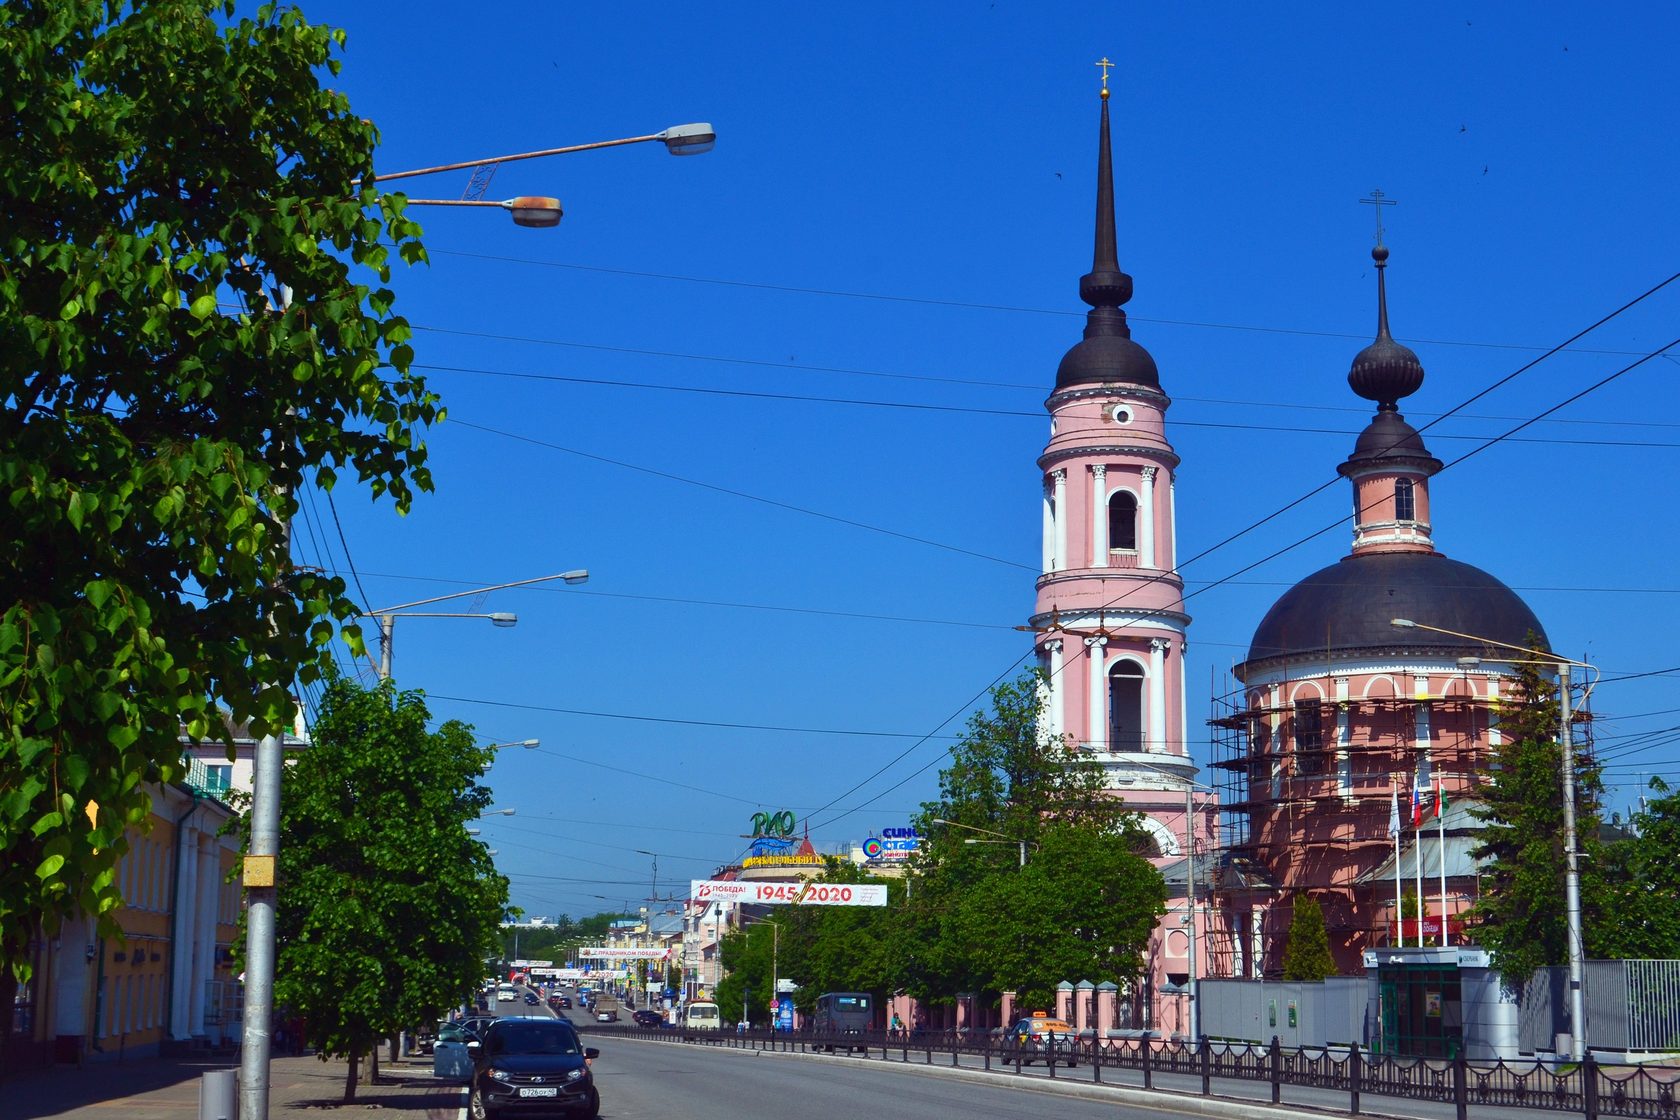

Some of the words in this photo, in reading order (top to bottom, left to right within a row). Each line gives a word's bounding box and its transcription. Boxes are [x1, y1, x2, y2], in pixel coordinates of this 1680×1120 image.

[749, 810, 796, 836] РИО
[712, 885, 747, 893] ПОБЕДА!
[756, 886, 797, 901] 1945
[807, 887, 853, 902] 2020
